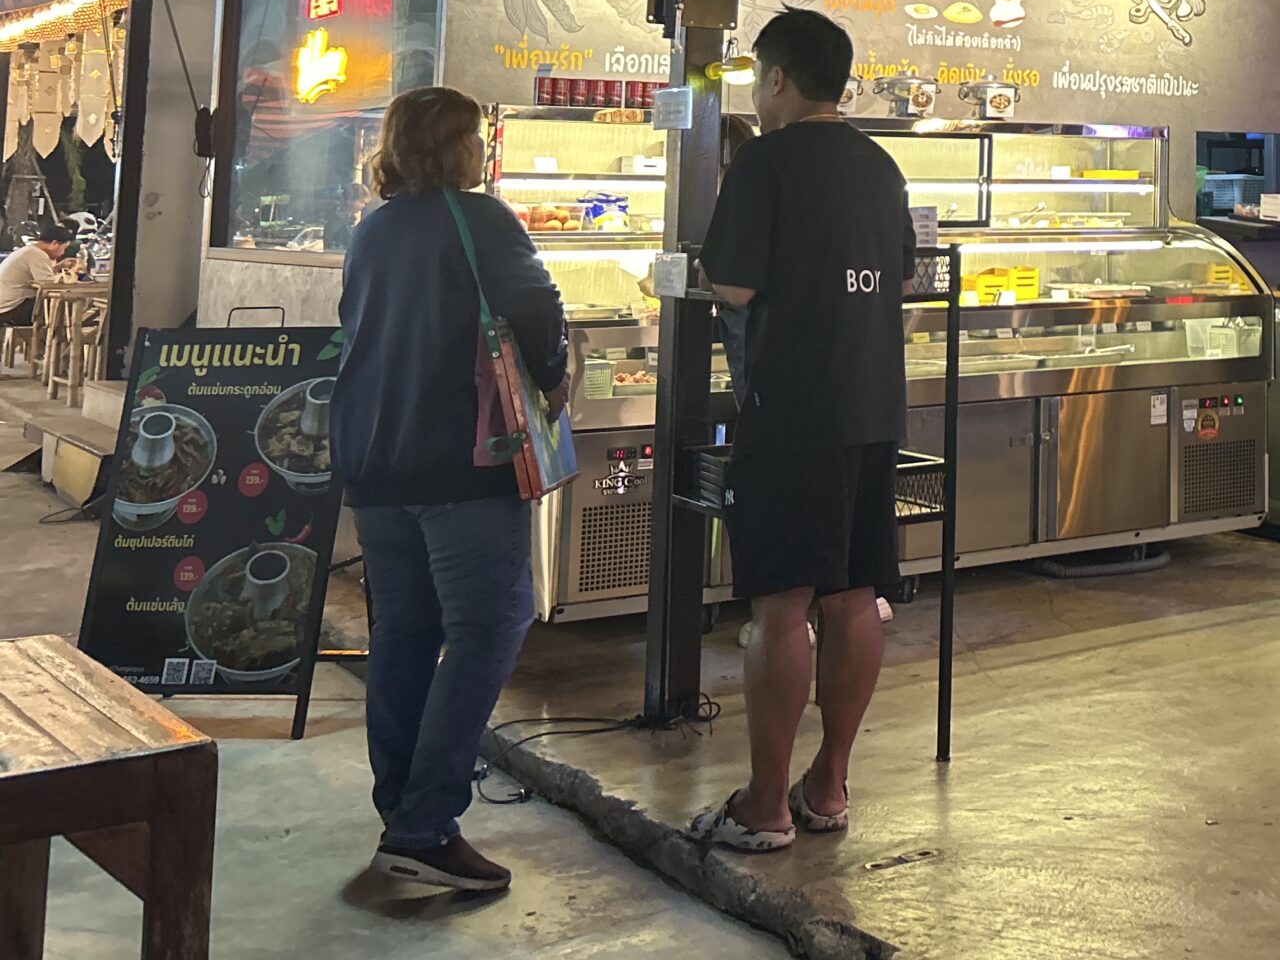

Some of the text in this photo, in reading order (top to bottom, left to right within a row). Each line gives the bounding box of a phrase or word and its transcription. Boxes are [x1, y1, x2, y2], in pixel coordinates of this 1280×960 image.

[847, 269, 881, 293] BOY
[159, 334, 301, 376] เมนูแนะนำ
[593, 475, 648, 489] KING Cool
